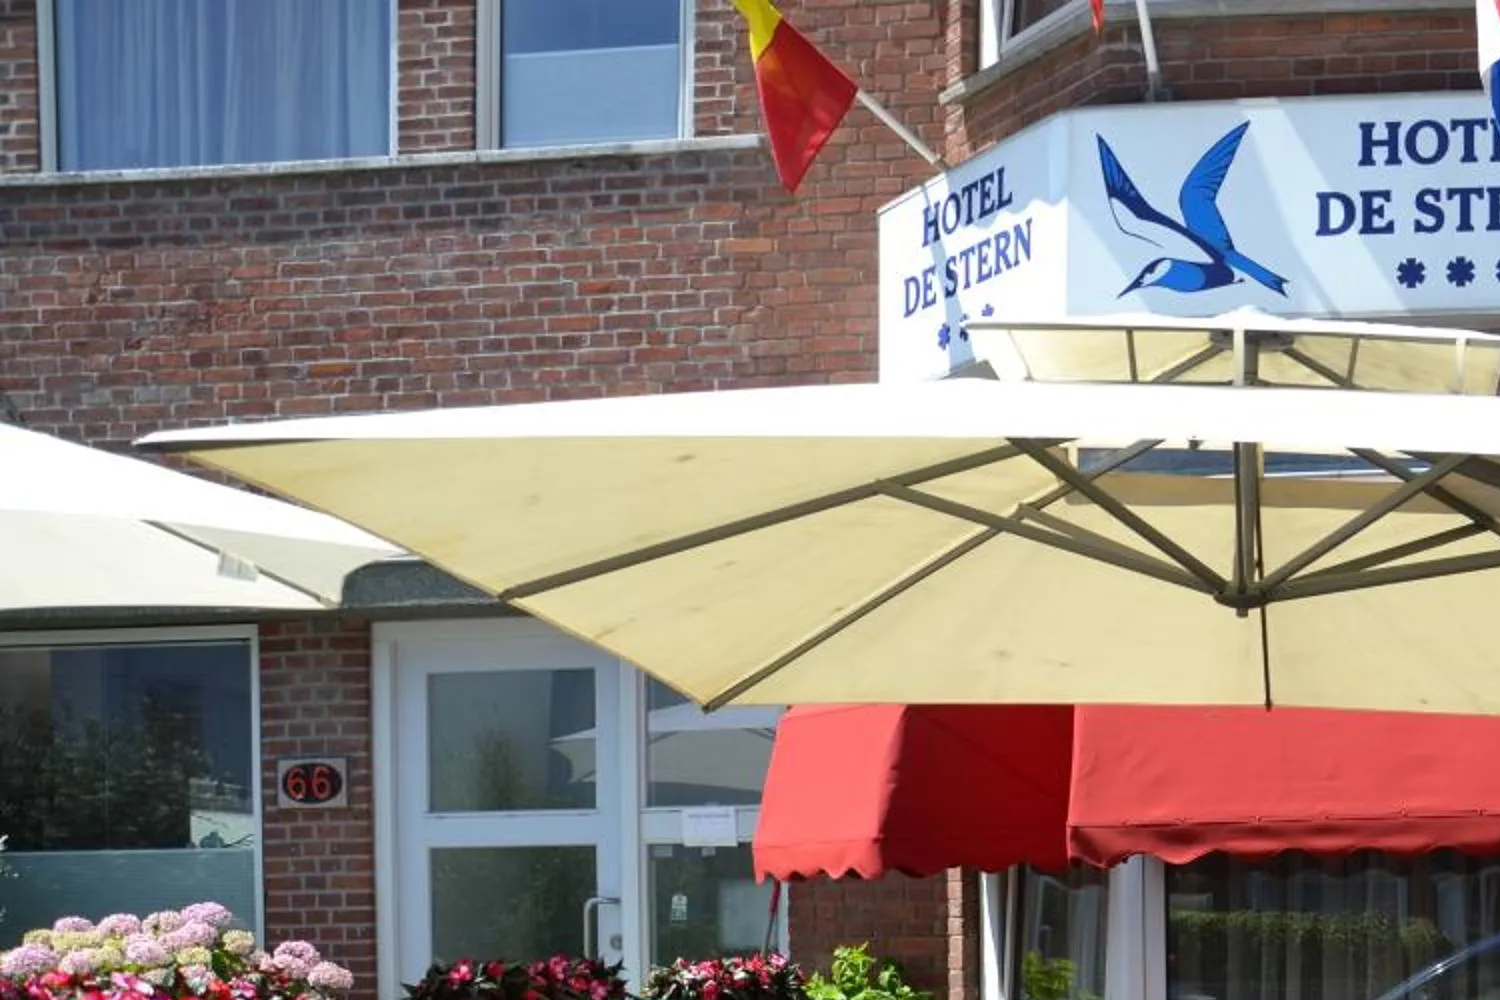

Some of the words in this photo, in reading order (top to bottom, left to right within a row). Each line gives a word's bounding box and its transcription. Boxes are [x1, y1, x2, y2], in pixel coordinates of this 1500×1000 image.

[922, 165, 1013, 248] HOTEL
[1315, 189, 1395, 237] DE
[903, 263, 937, 319] DE
[944, 217, 1033, 299] STERN
[286, 765, 332, 801] 66
